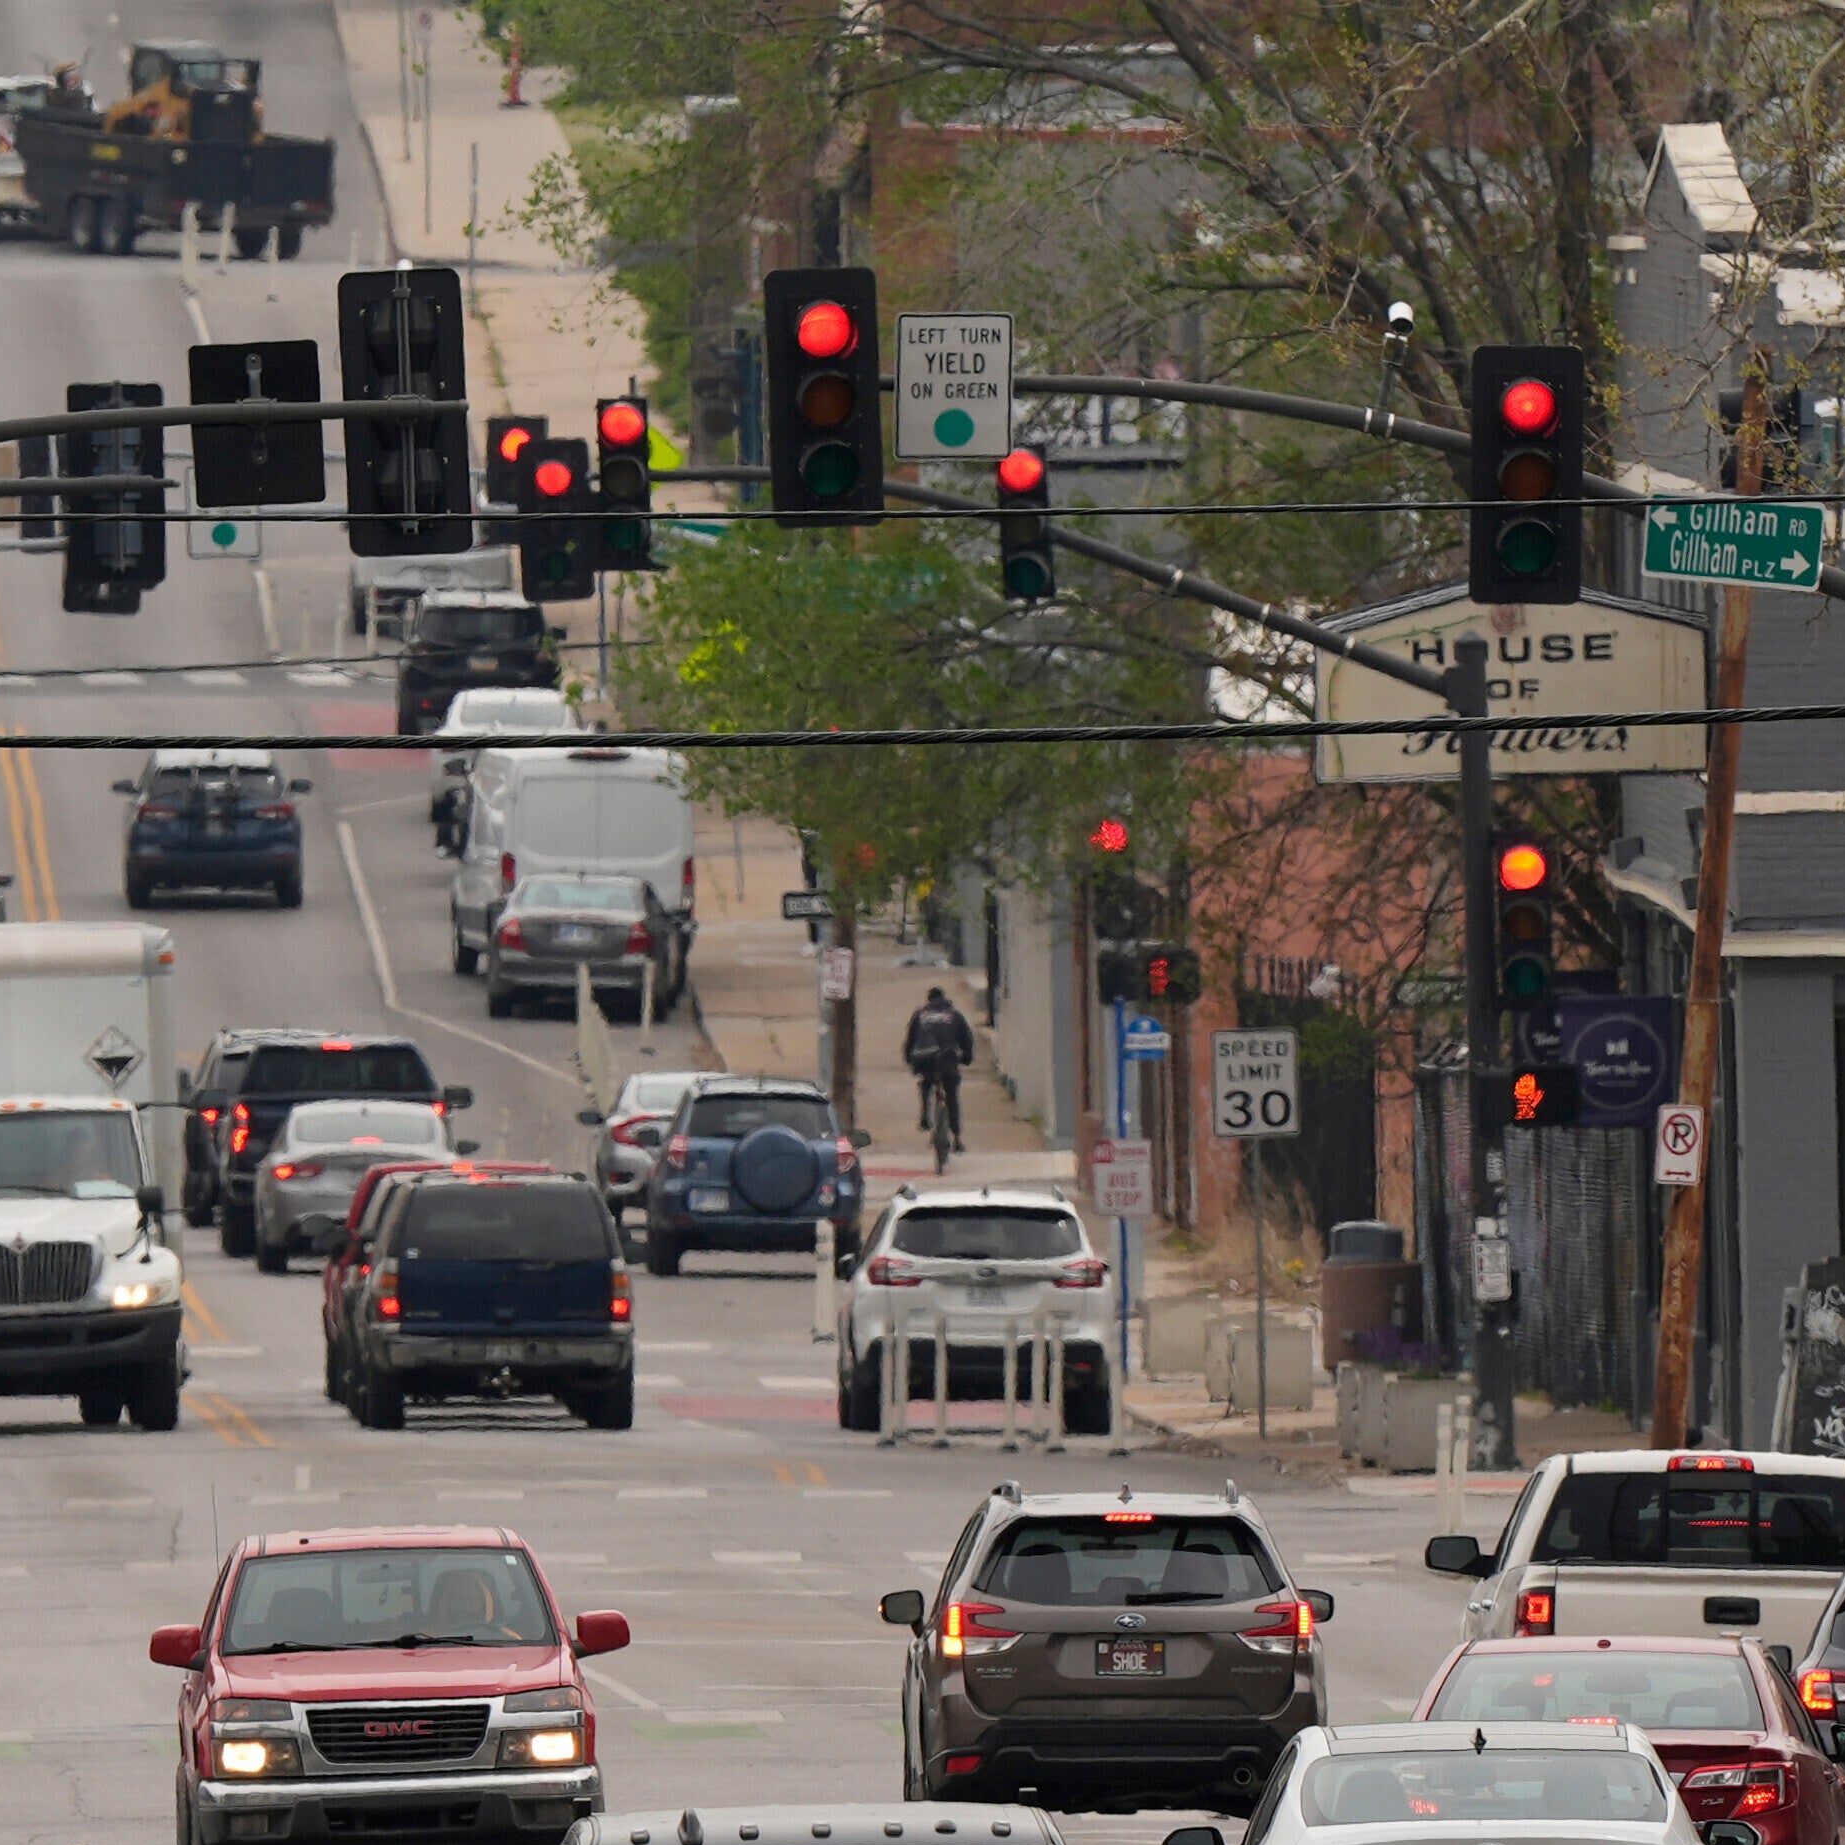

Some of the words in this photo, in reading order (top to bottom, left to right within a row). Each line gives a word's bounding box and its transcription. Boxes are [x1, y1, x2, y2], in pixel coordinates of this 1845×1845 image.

[908, 327, 946, 344] LEFT
[959, 327, 1002, 344] TURN
[924, 352, 986, 374] YIELD
[911, 382, 933, 399] ON
[944, 382, 998, 399] GREEN
[1689, 503, 1779, 537] Gillham
[1788, 518, 1808, 537] RD
[1670, 530, 1738, 575] Gillham
[1741, 558, 1777, 579] PLZ
[1411, 632, 1615, 666] HUSE
[1486, 678, 1540, 701] OF
[1218, 1040, 1289, 1058] SPEED
[1226, 1063, 1284, 1083] LIMIT
[1223, 1090, 1291, 1129] 30
[1112, 1652, 1148, 1671] SHOE
[364, 1720, 435, 1737] GMC
